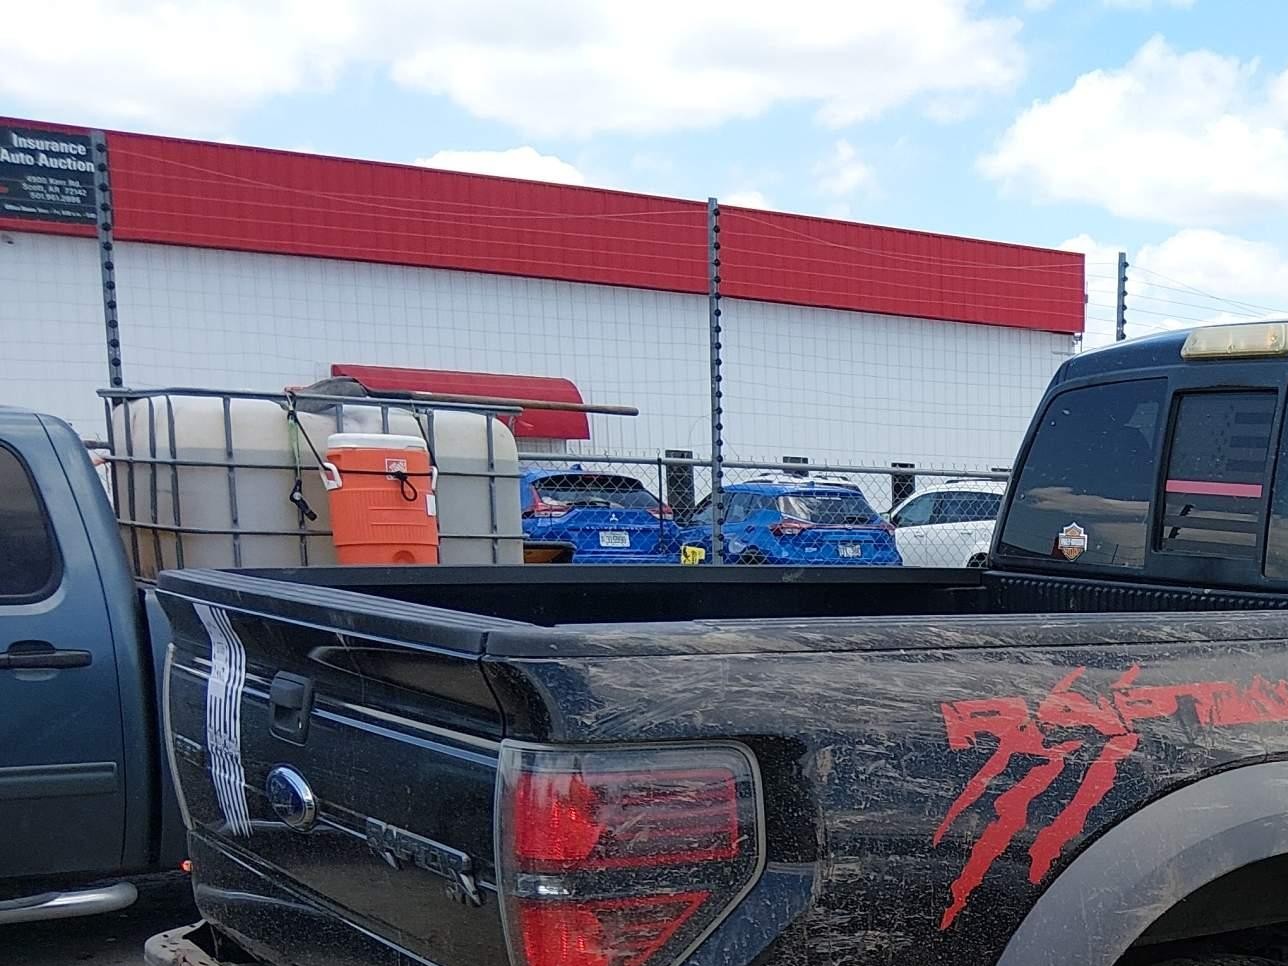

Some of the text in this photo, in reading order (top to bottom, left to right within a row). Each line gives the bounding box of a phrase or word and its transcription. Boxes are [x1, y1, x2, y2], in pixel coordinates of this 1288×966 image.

[12, 133, 87, 155] Insurance
[0, 149, 95, 172] Auto Auction
